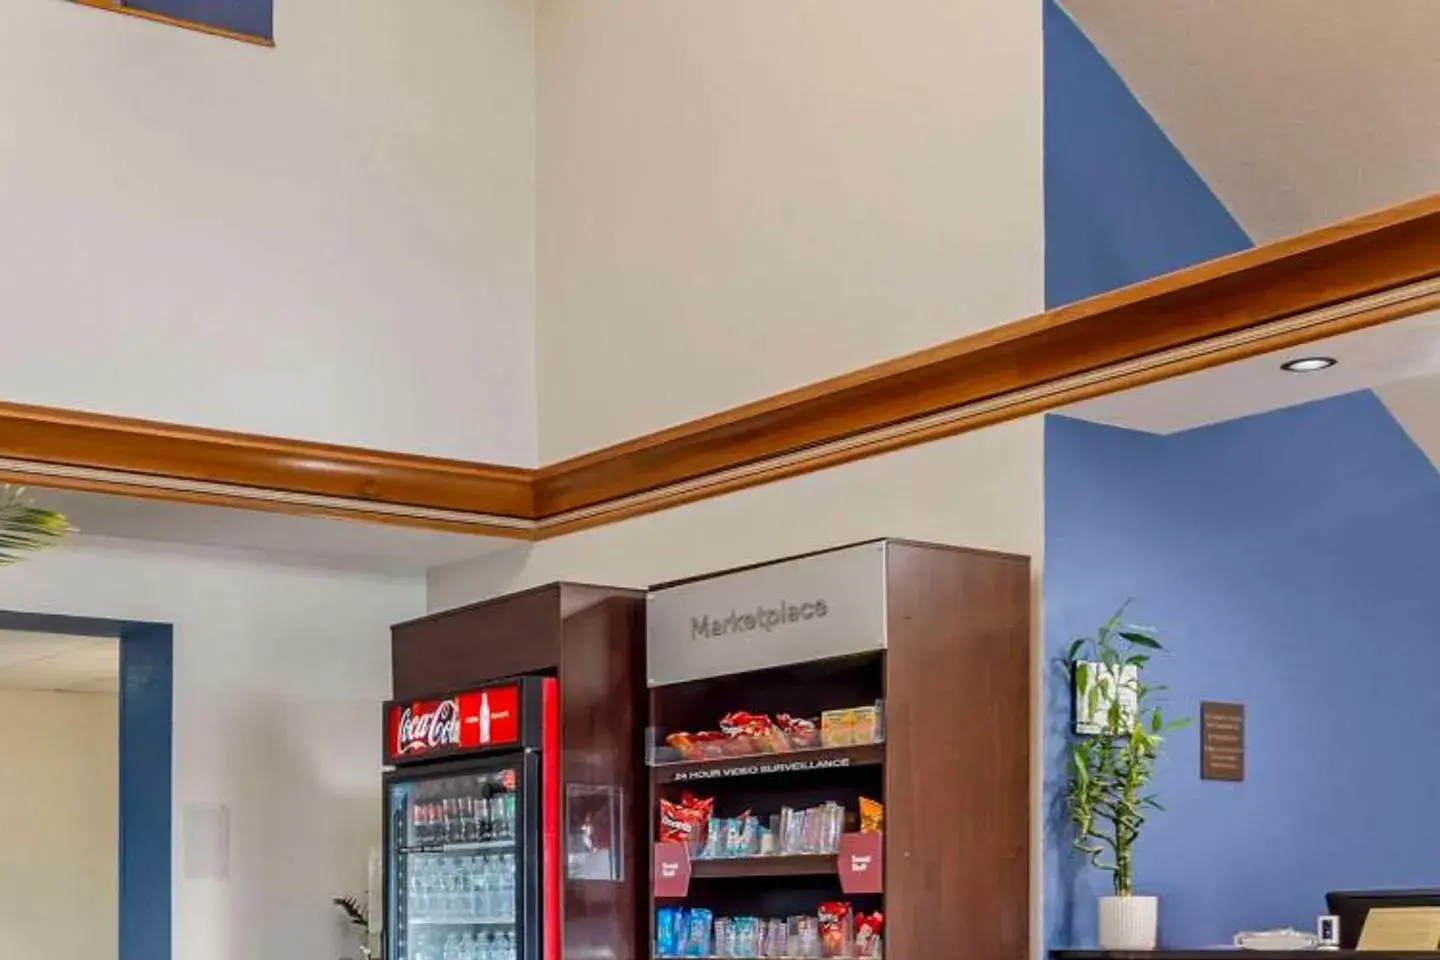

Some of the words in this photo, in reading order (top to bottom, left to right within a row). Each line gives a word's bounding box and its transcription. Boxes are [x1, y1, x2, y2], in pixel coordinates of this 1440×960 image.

[691, 599, 829, 640] Marketplace
[674, 772, 688, 781] 24
[689, 769, 721, 780] HOUR
[723, 765, 758, 777] VIDEO
[760, 758, 850, 773] SURVEILLANCE
